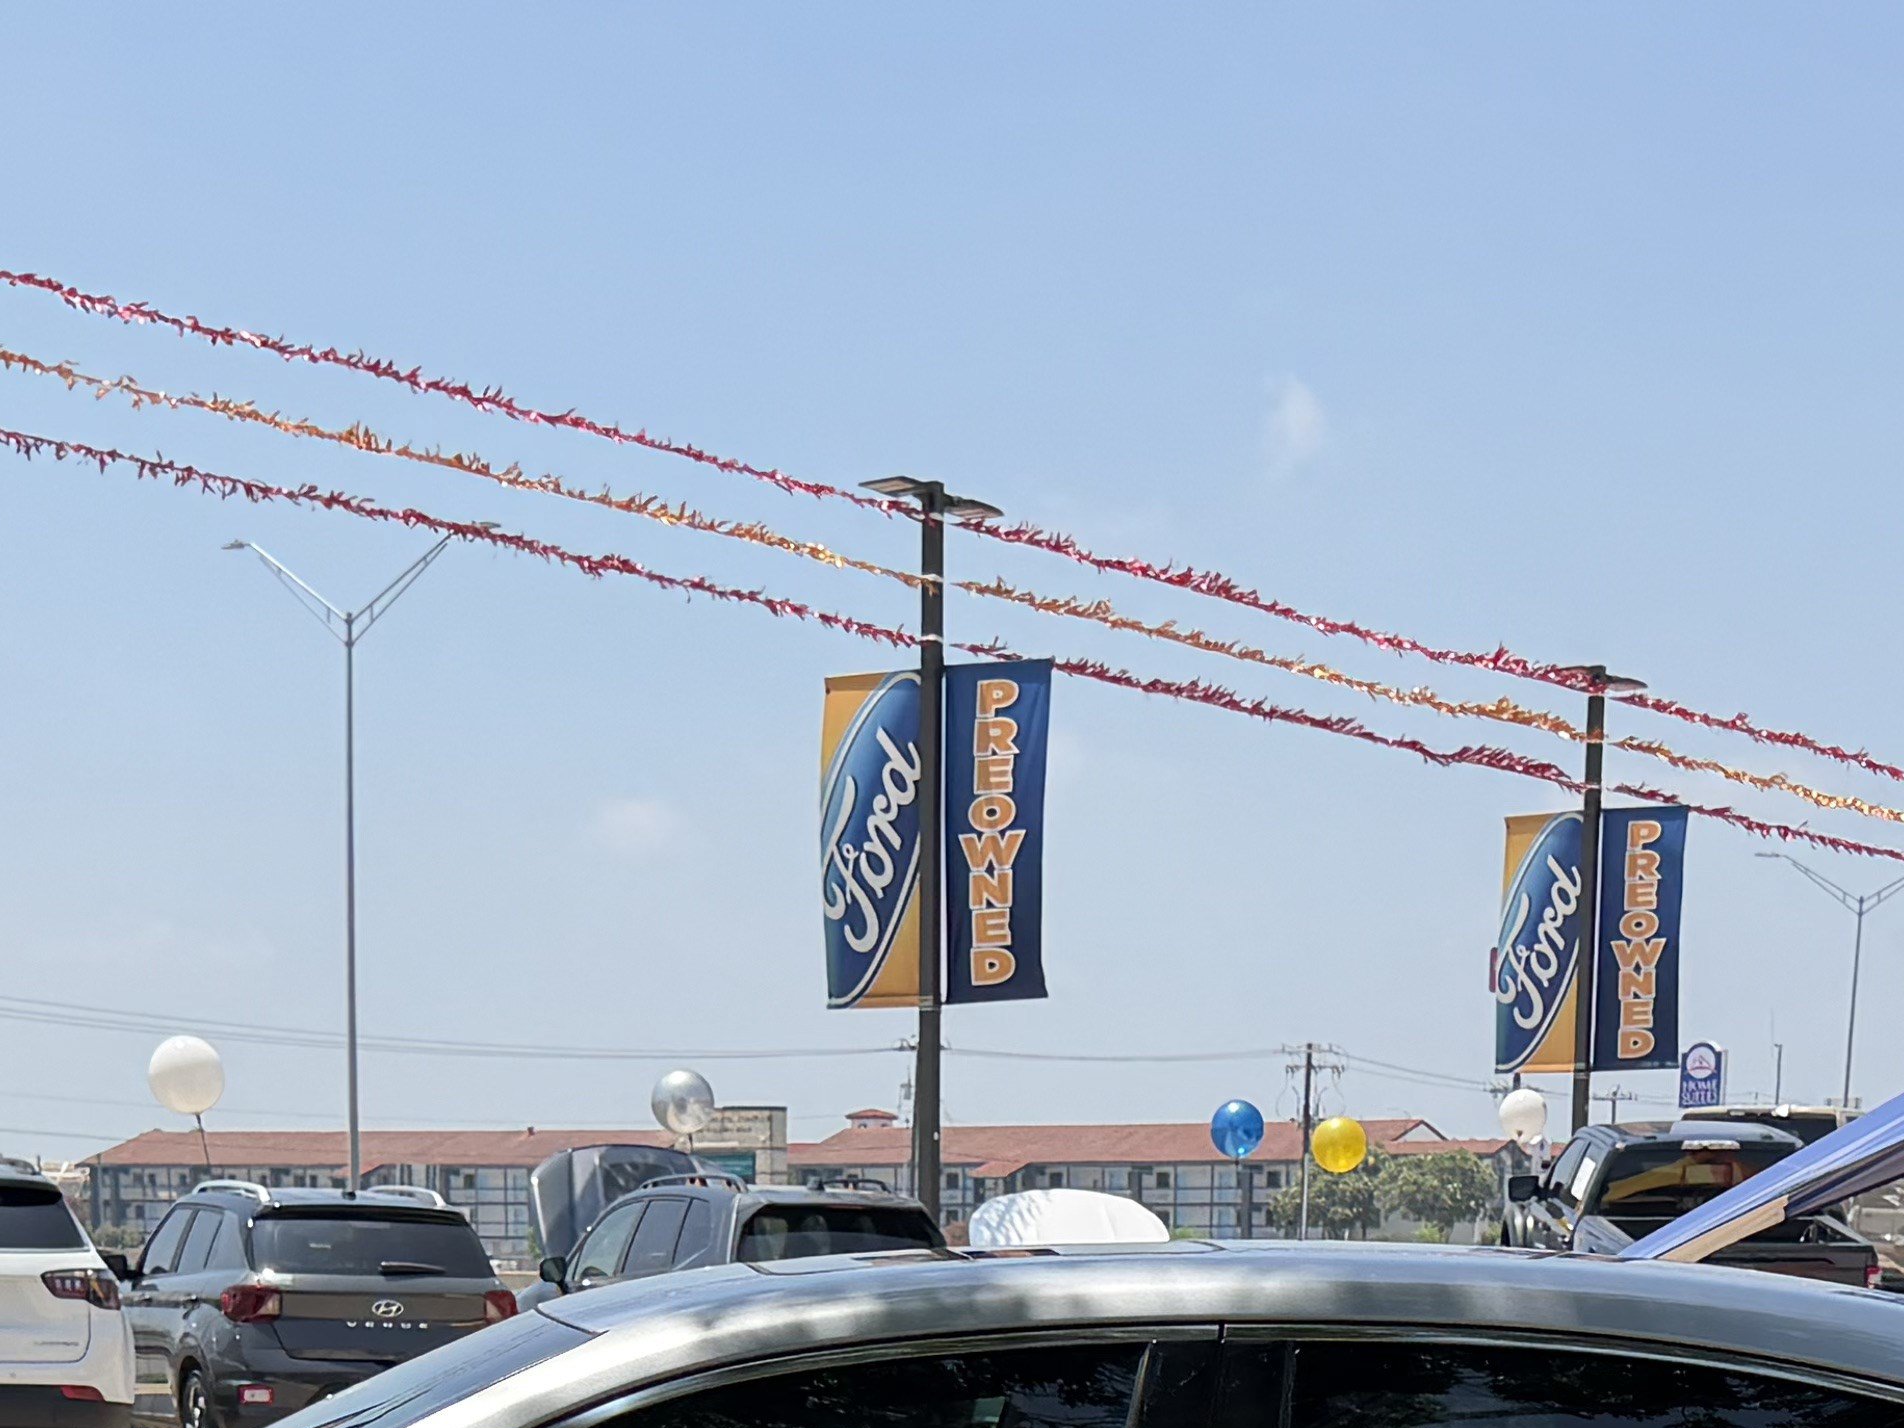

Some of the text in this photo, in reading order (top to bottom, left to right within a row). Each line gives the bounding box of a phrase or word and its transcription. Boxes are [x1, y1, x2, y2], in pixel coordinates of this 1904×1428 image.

[823, 726, 922, 953] Ford
[958, 679, 1027, 986] PREOWNED
[1496, 854, 1582, 1030] Ford
[1610, 819, 1667, 1060] PREOWNED
